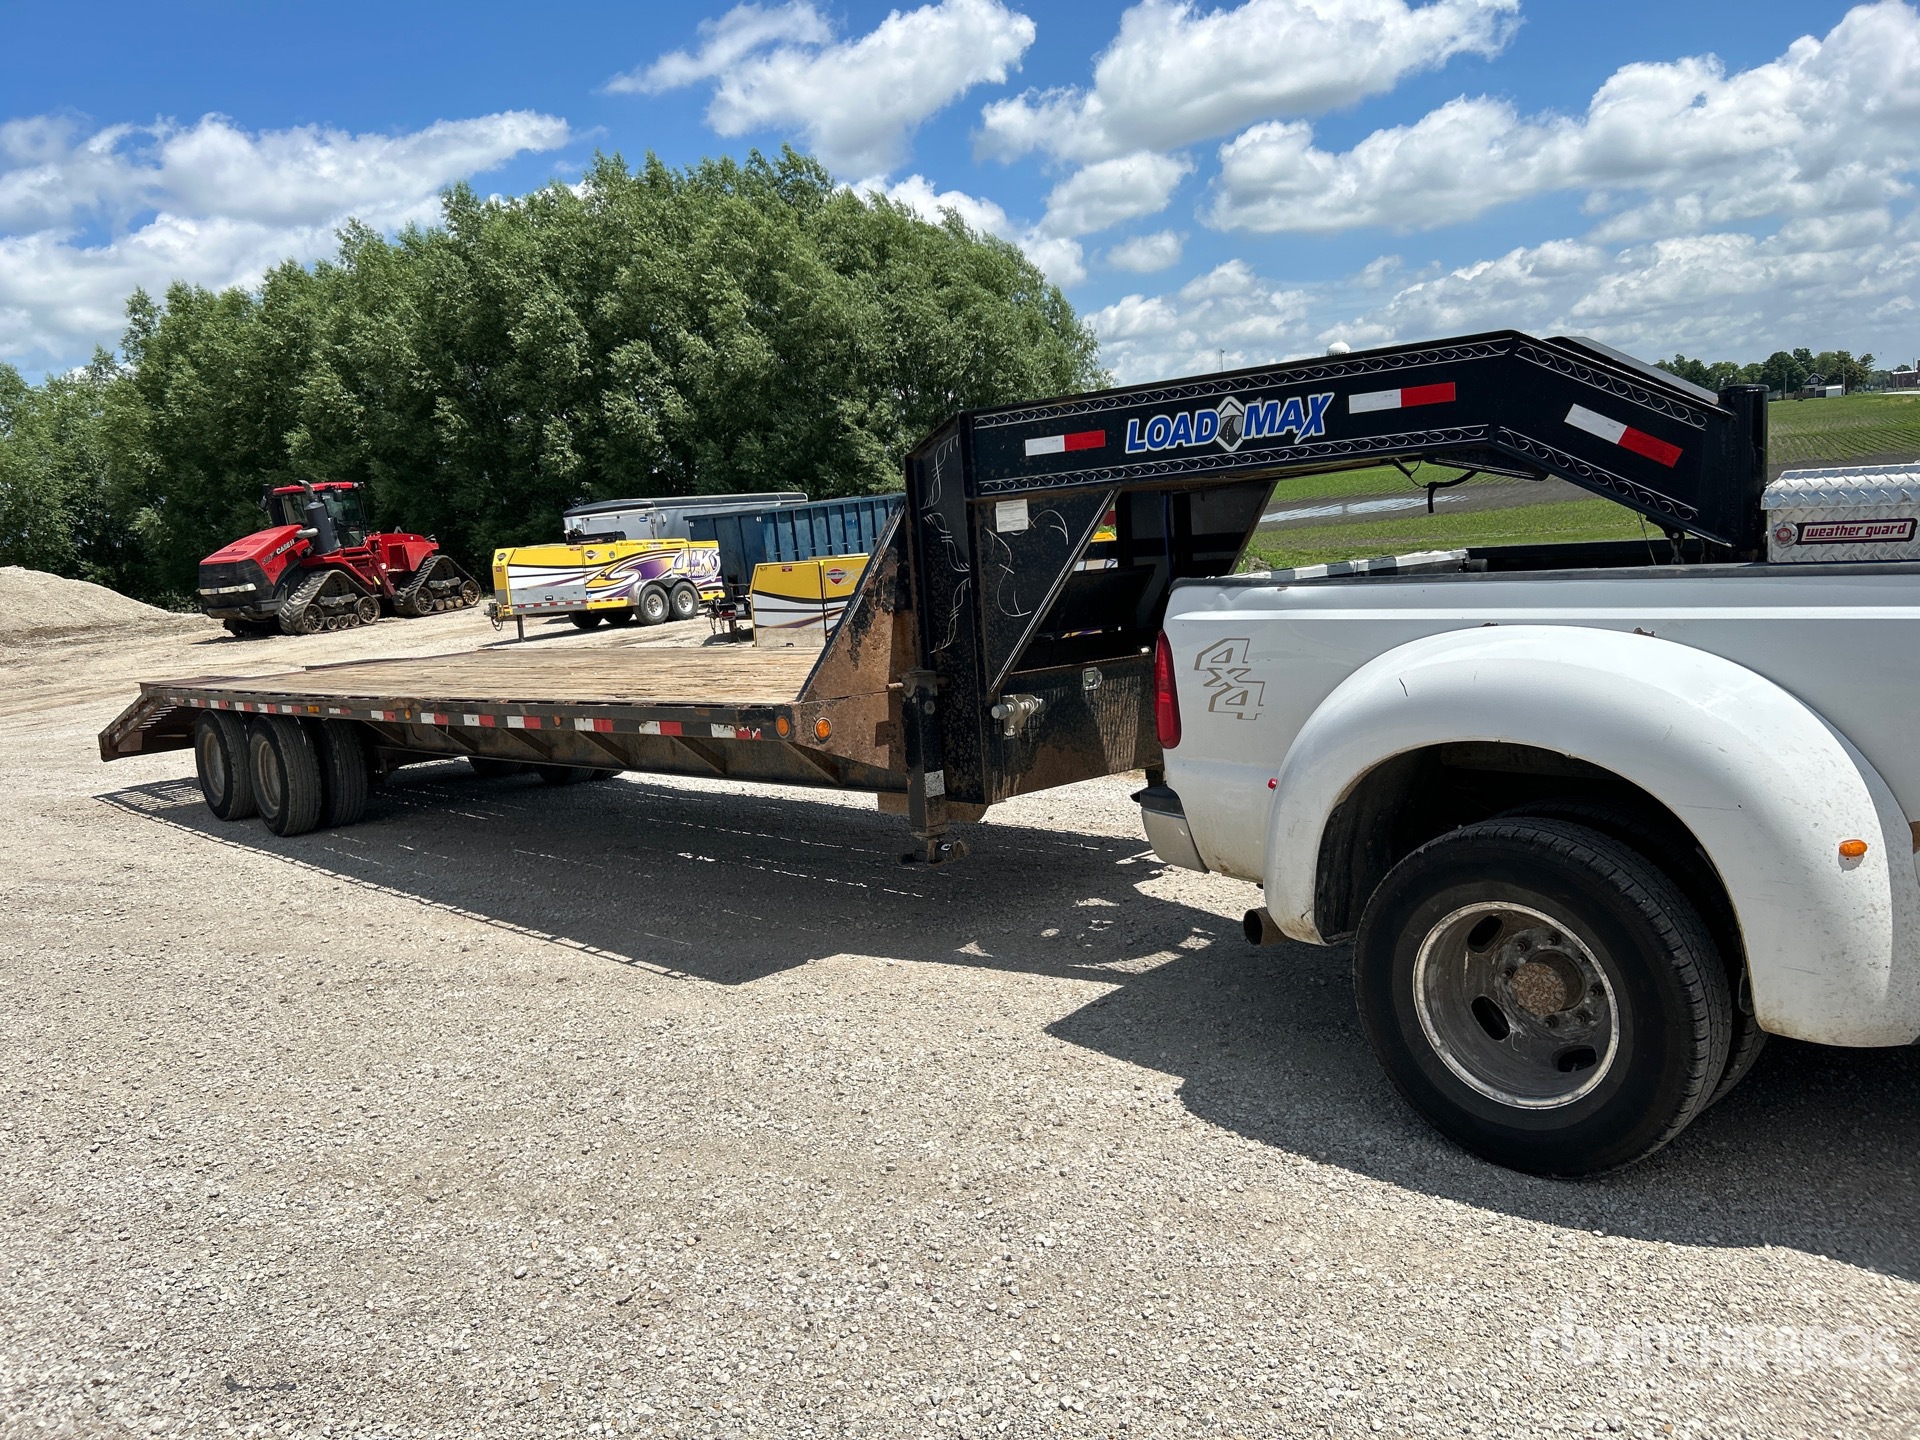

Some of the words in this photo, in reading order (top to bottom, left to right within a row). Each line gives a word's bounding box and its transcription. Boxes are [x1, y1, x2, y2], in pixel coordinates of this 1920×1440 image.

[1125, 408, 1220, 454] LOAD
[1241, 392, 1335, 444] MAX
[1806, 525, 1863, 537] weather
[1866, 523, 1906, 537] guard
